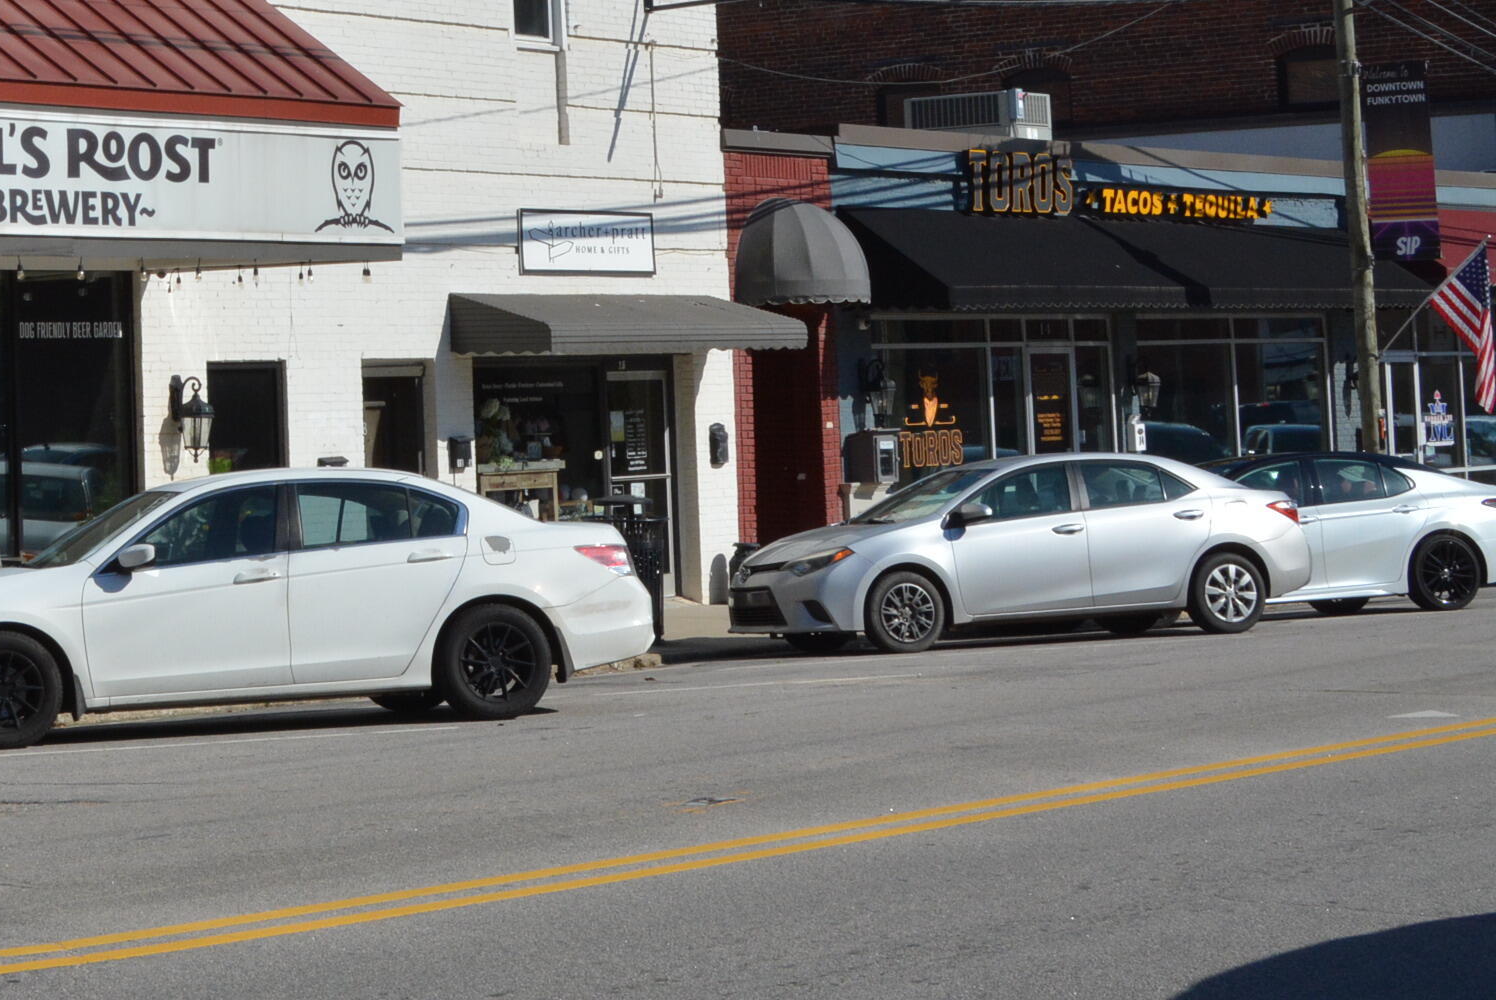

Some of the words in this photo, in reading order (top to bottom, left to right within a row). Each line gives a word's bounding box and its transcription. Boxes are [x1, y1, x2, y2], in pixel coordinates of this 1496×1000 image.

[1367, 81, 1424, 93] DOWNTOWN
[1367, 93, 1426, 105] FUNKYTOWN
[969, 150, 1074, 215] TOROS
[1102, 188, 1163, 215] TACOS
[1182, 193, 1259, 219] TEQUILA
[575, 246, 597, 254] HOME
[608, 246, 630, 254] GIFTS
[1396, 236, 1421, 255] SIP
[19, 321, 35, 338] DOG
[37, 321, 70, 338] FRIENDLY
[72, 321, 91, 338] BEER
[94, 321, 122, 338] GARDEN
[898, 429, 964, 468] TOROS
